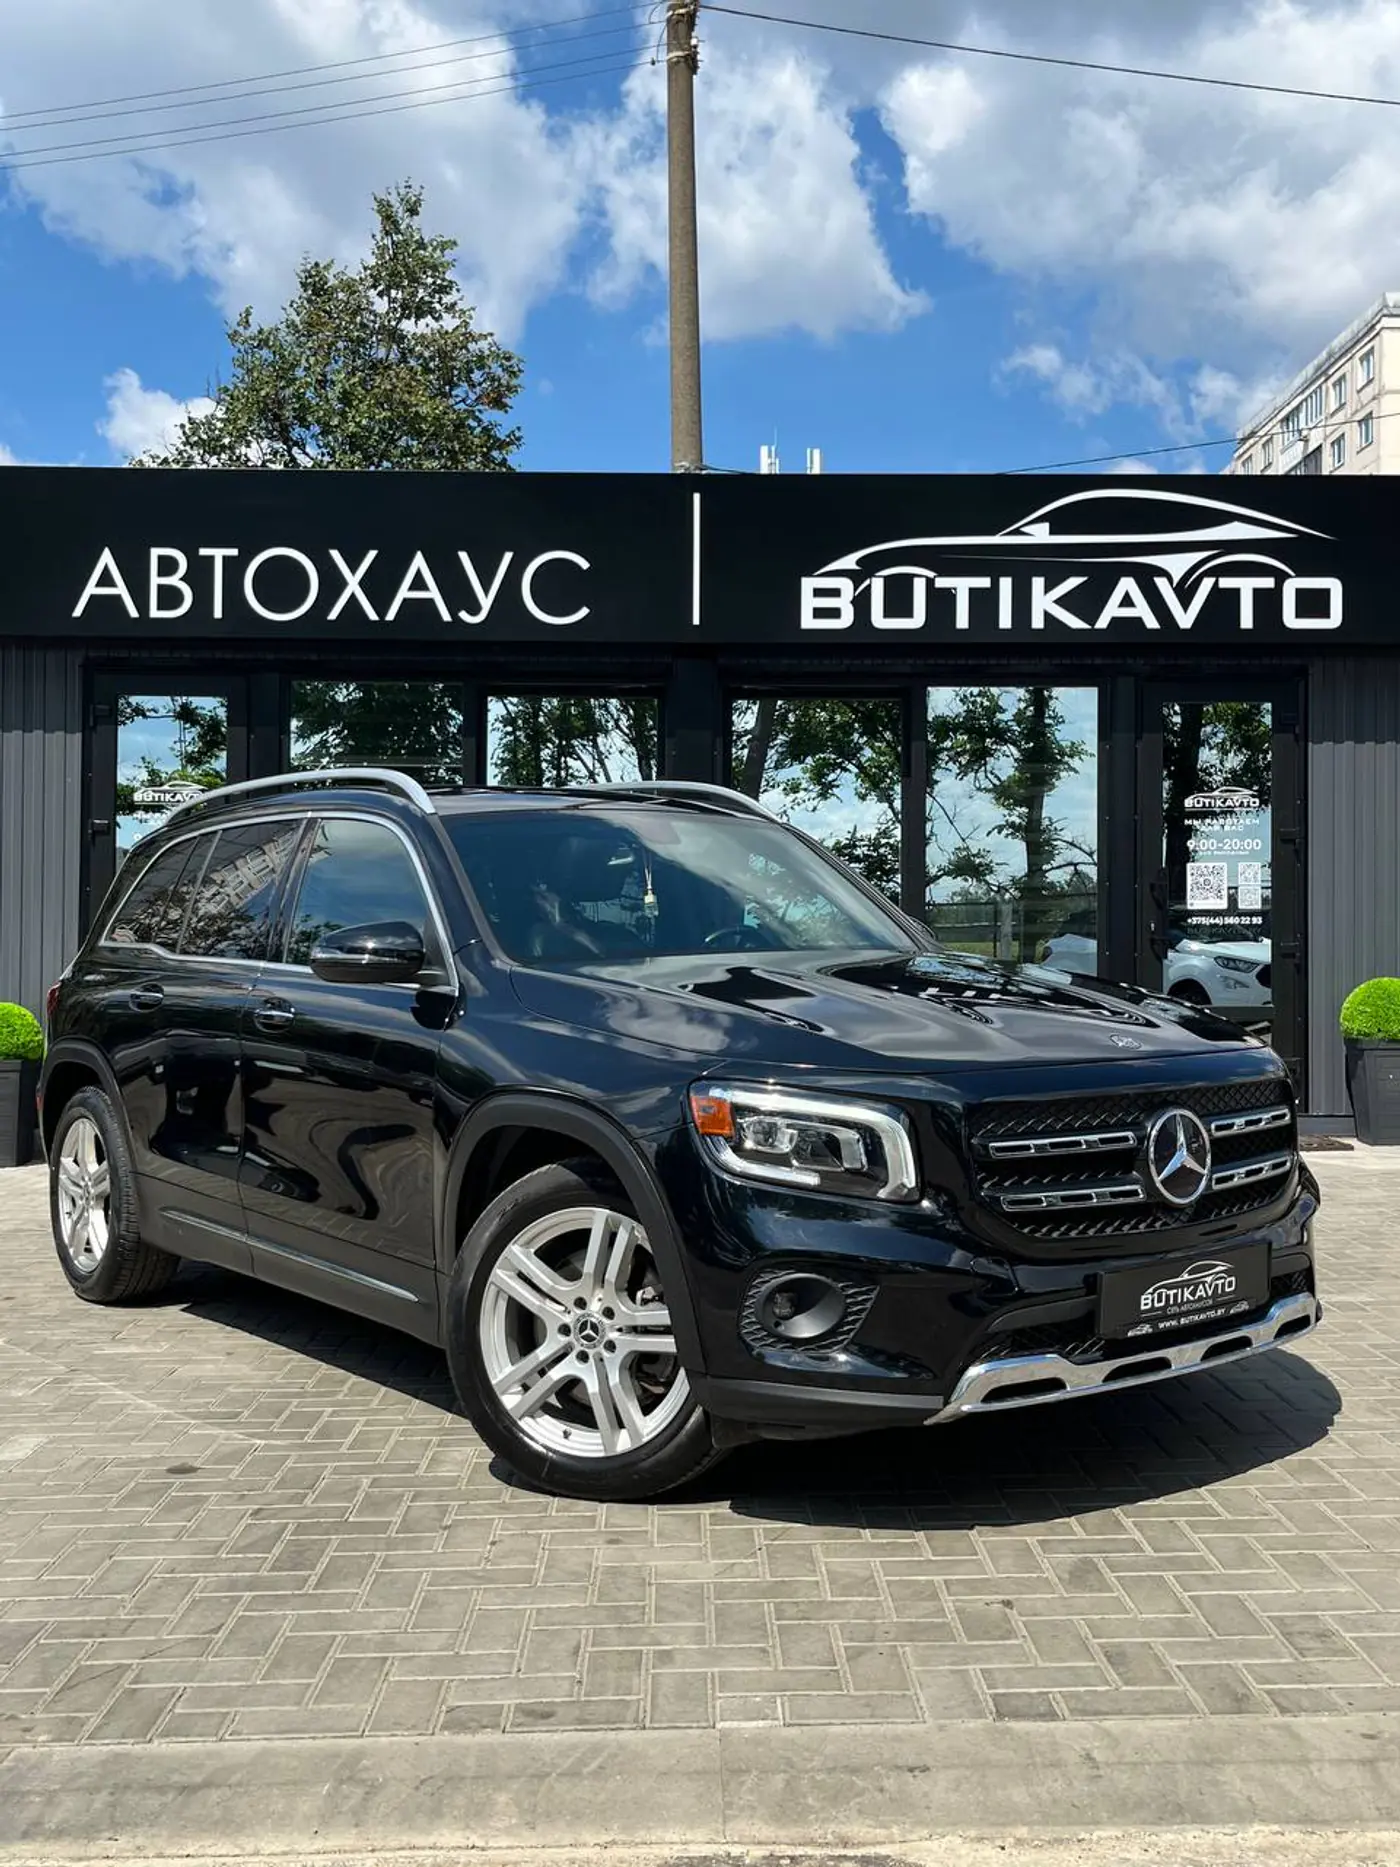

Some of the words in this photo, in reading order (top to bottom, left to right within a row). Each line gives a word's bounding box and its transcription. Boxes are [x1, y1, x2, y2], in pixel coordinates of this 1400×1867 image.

[72, 546, 591, 625] АВТОХАУС
[800, 576, 1343, 630] BUTIKAVTO
[133, 792, 200, 802] BUTIKAVT
[1184, 798, 1260, 808] BUTIKAVTO
[1140, 1276, 1236, 1311] BUTIKAVTO
